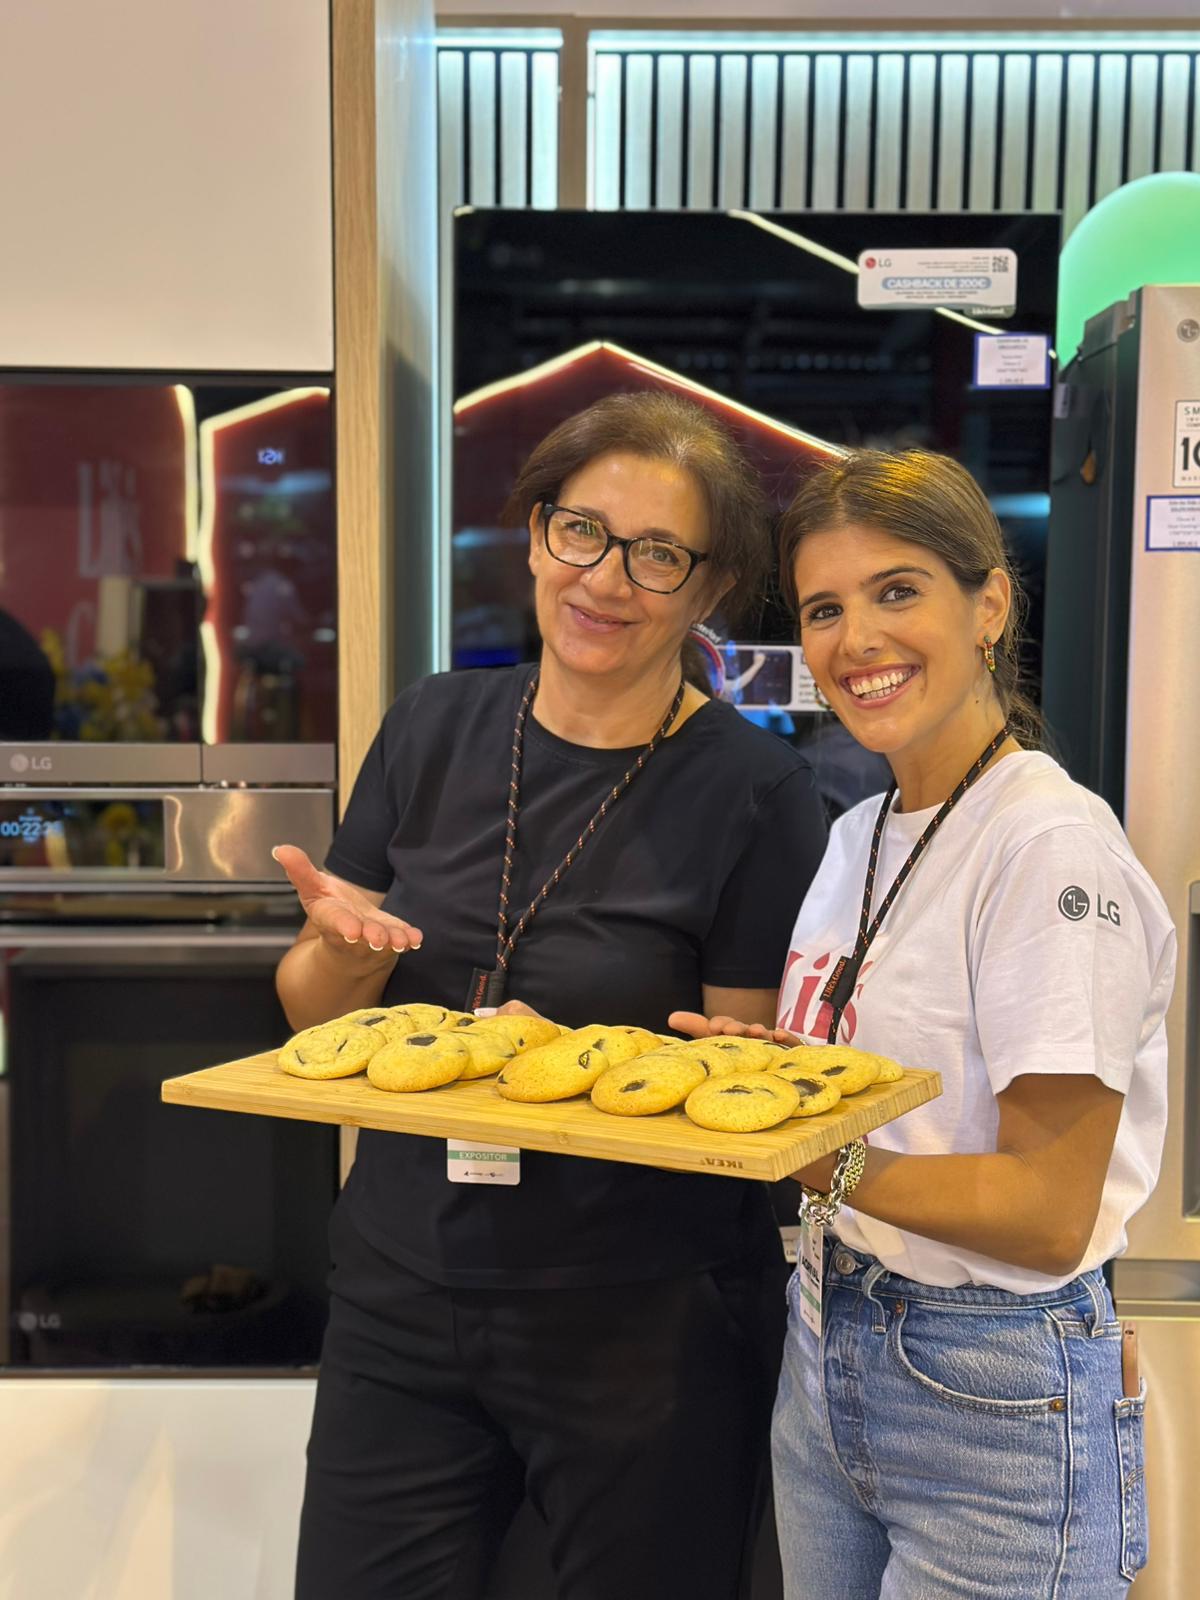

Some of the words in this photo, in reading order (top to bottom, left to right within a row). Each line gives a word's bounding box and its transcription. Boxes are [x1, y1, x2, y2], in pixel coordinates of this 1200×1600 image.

[878, 258, 892, 268] LG
[887, 277, 941, 289] CASHBACK
[944, 277, 957, 289] DE
[31, 756, 52, 770] LG
[1097, 893, 1121, 927] LG
[459, 1151, 507, 1161] EXPOSITOR
[39, 1312, 61, 1329] LG
